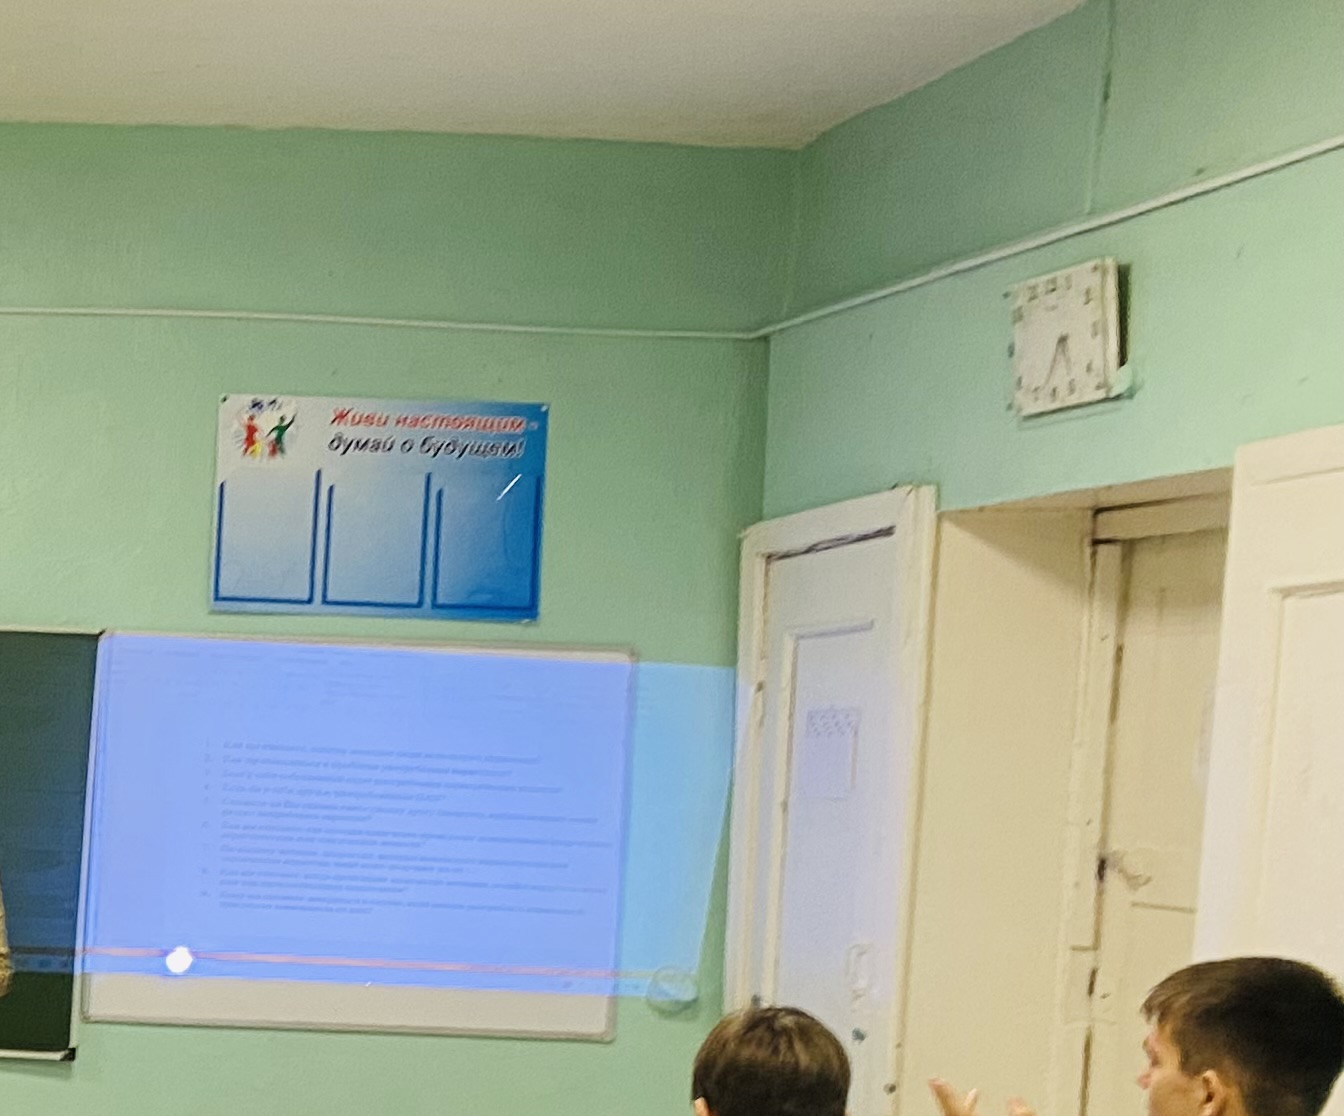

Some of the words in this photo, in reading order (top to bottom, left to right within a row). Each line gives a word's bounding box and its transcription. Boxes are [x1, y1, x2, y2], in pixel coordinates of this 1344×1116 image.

[329, 406, 390, 427] Живи
[394, 411, 526, 434] настоящим
[327, 431, 395, 456] думай
[400, 439, 413, 453] о
[419, 435, 525, 459] будущем!
